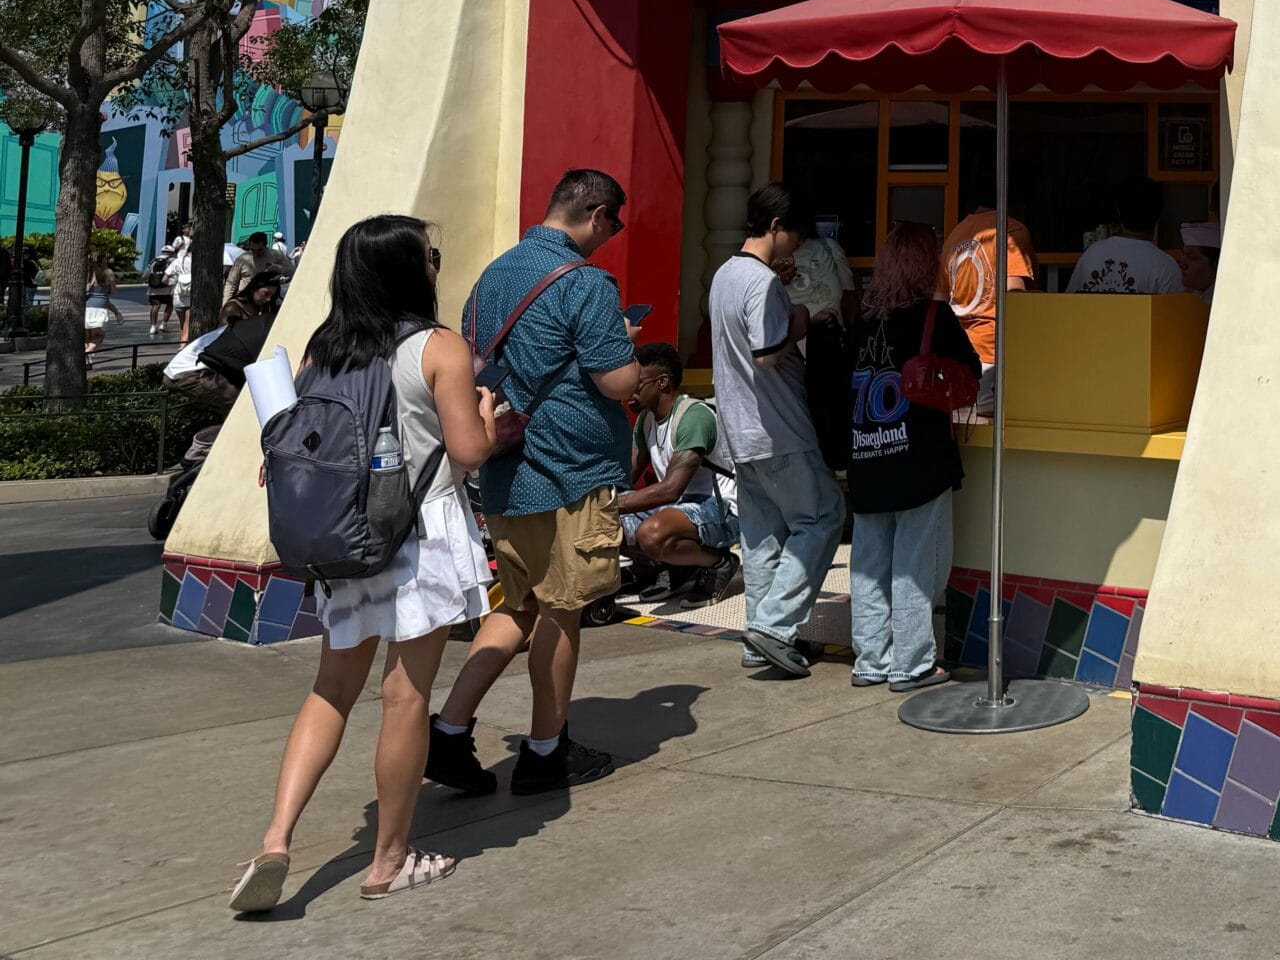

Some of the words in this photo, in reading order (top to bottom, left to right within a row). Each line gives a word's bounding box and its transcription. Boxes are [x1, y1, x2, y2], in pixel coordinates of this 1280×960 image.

[851, 368, 911, 424] 70
[852, 421, 908, 450] Disneyland
[883, 443, 910, 456] HAPPY
